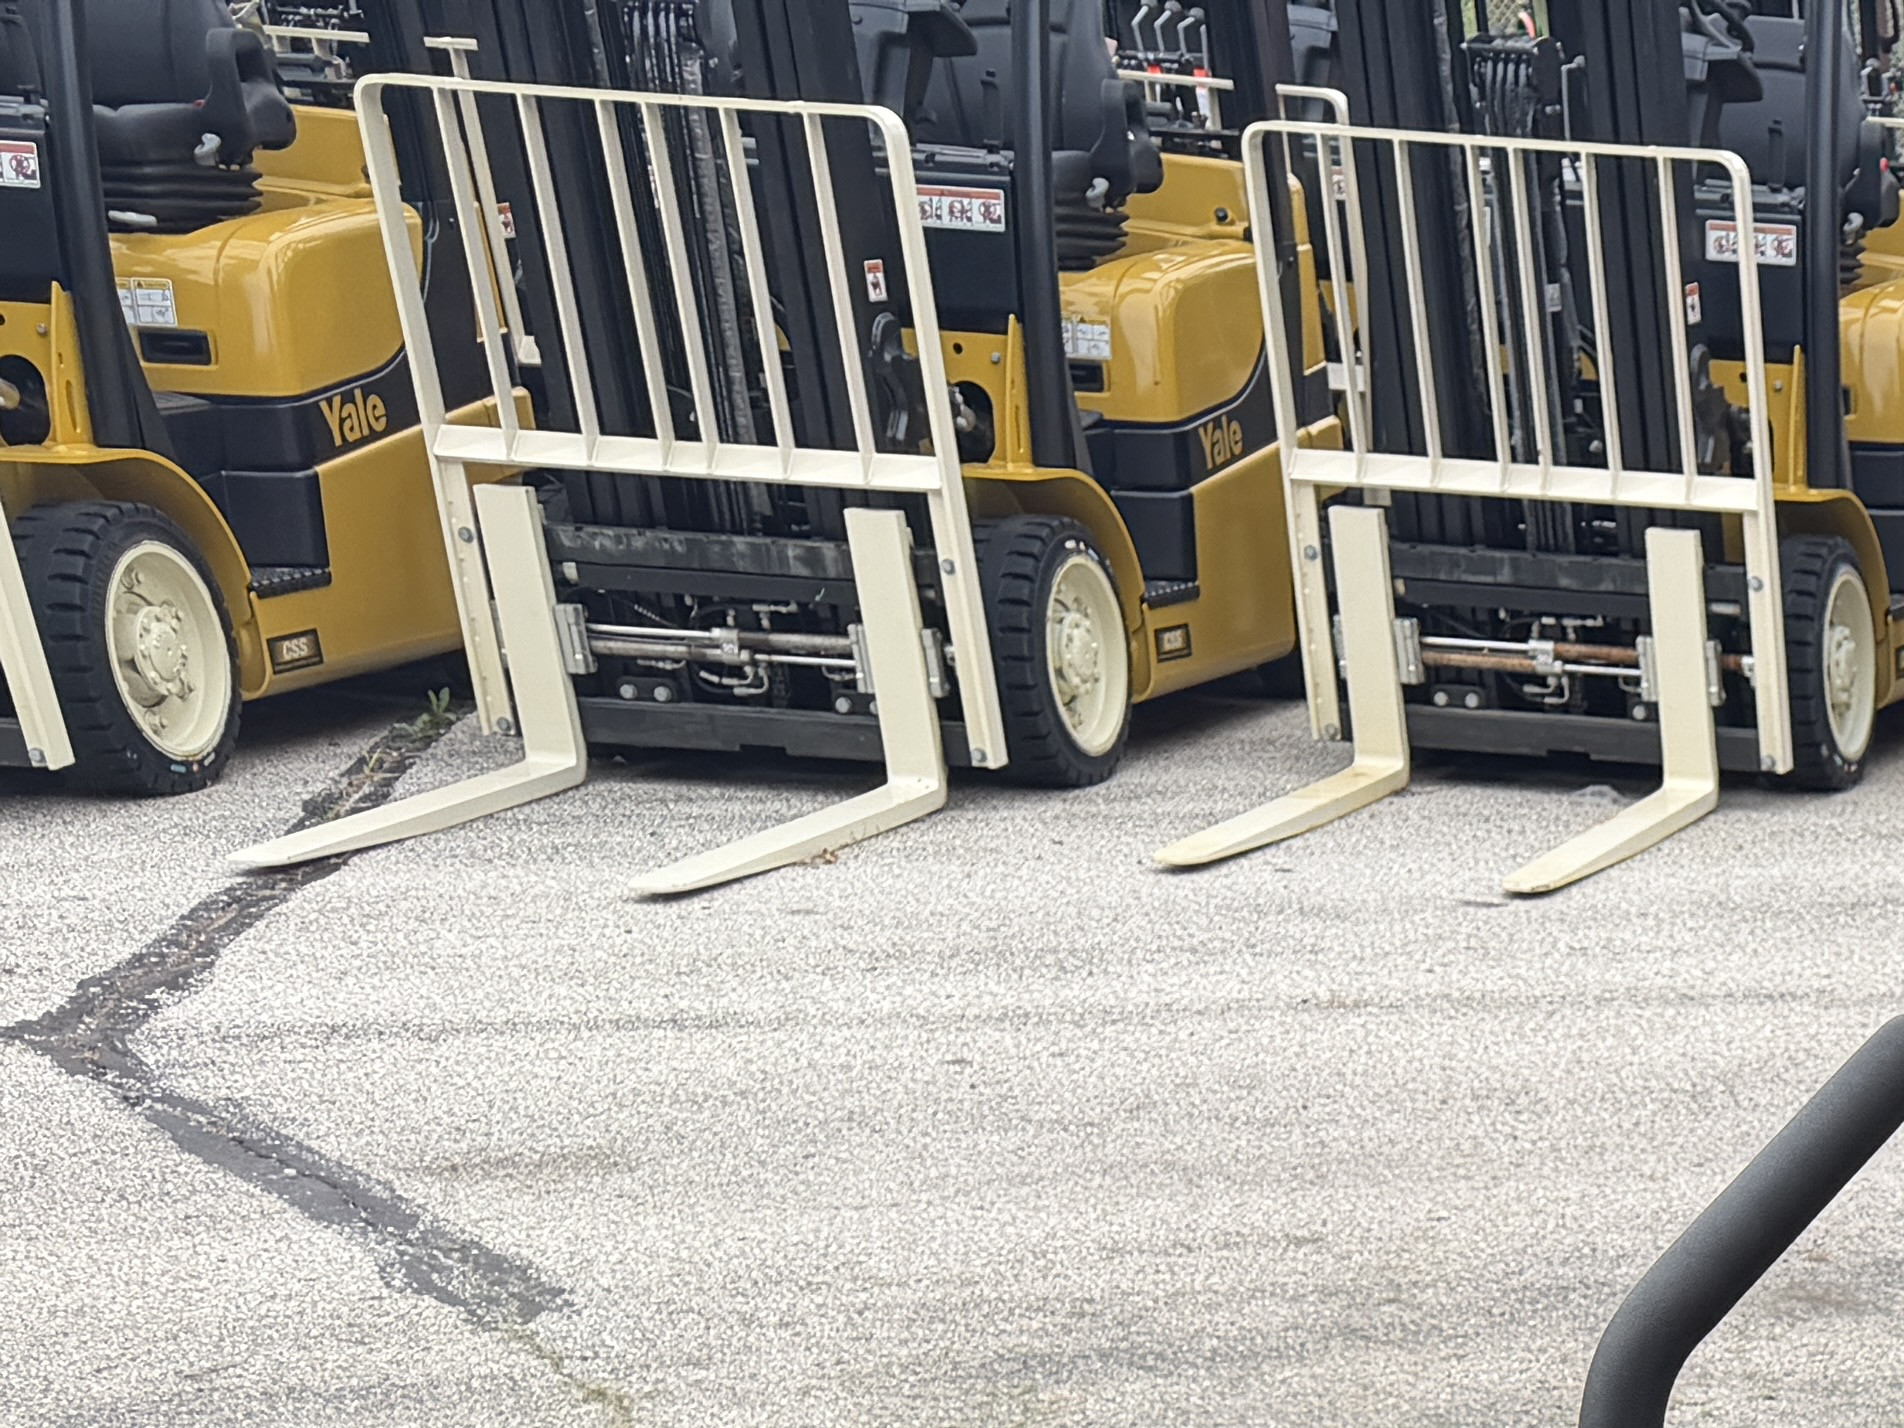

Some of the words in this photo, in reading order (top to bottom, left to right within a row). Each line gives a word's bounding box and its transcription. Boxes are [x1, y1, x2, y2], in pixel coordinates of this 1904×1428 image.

[319, 387, 387, 447] Yale
[1199, 414, 1243, 469] Yale
[283, 638, 307, 661] CSS
